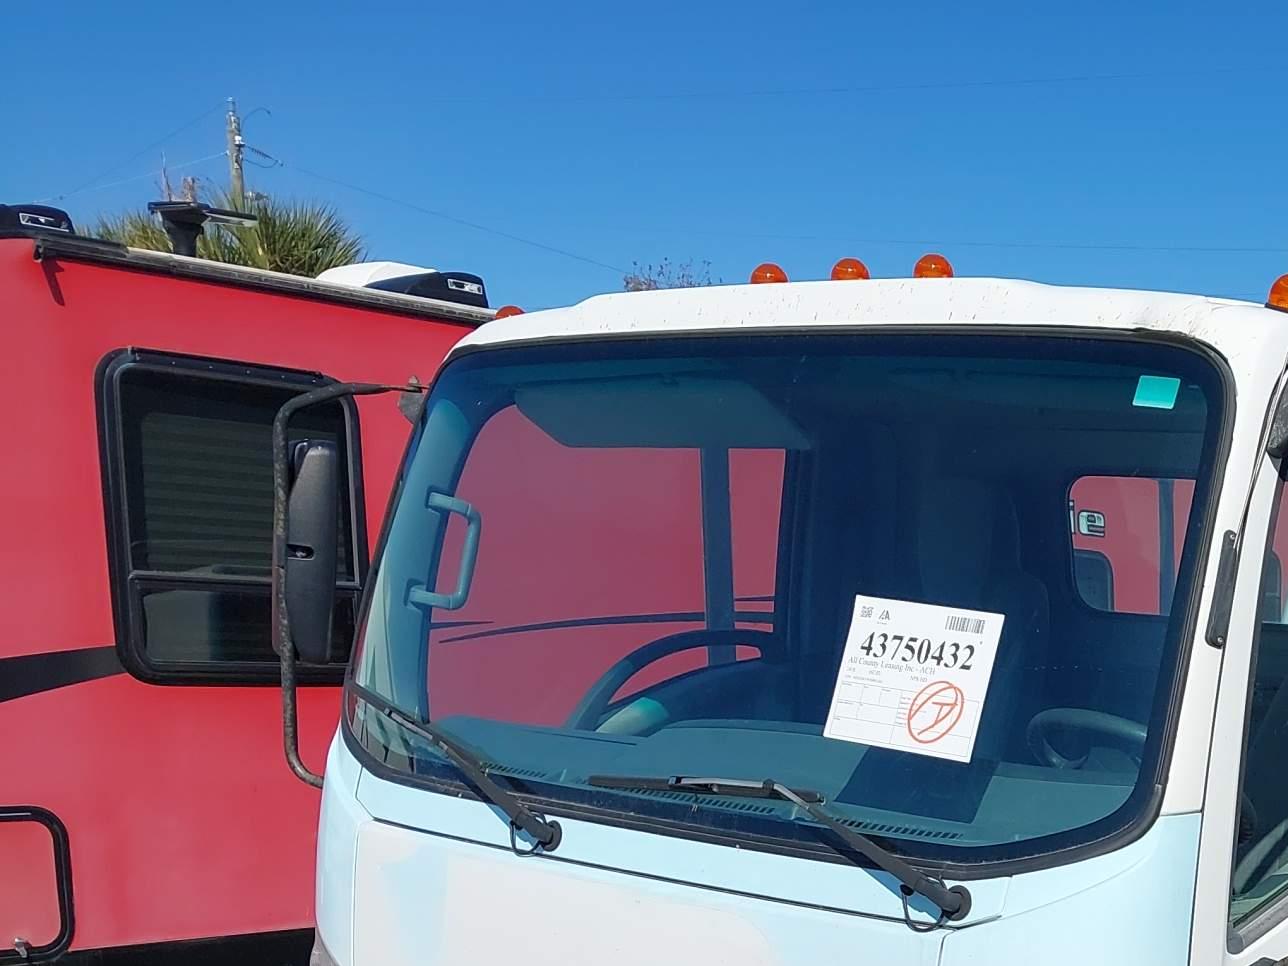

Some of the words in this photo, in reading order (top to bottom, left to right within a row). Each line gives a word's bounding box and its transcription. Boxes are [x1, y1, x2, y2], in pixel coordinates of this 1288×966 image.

[848, 656, 857, 665] All
[857, 657, 879, 669] County
[880, 659, 903, 672] Leasing
[860, 631, 975, 671] 43750432
